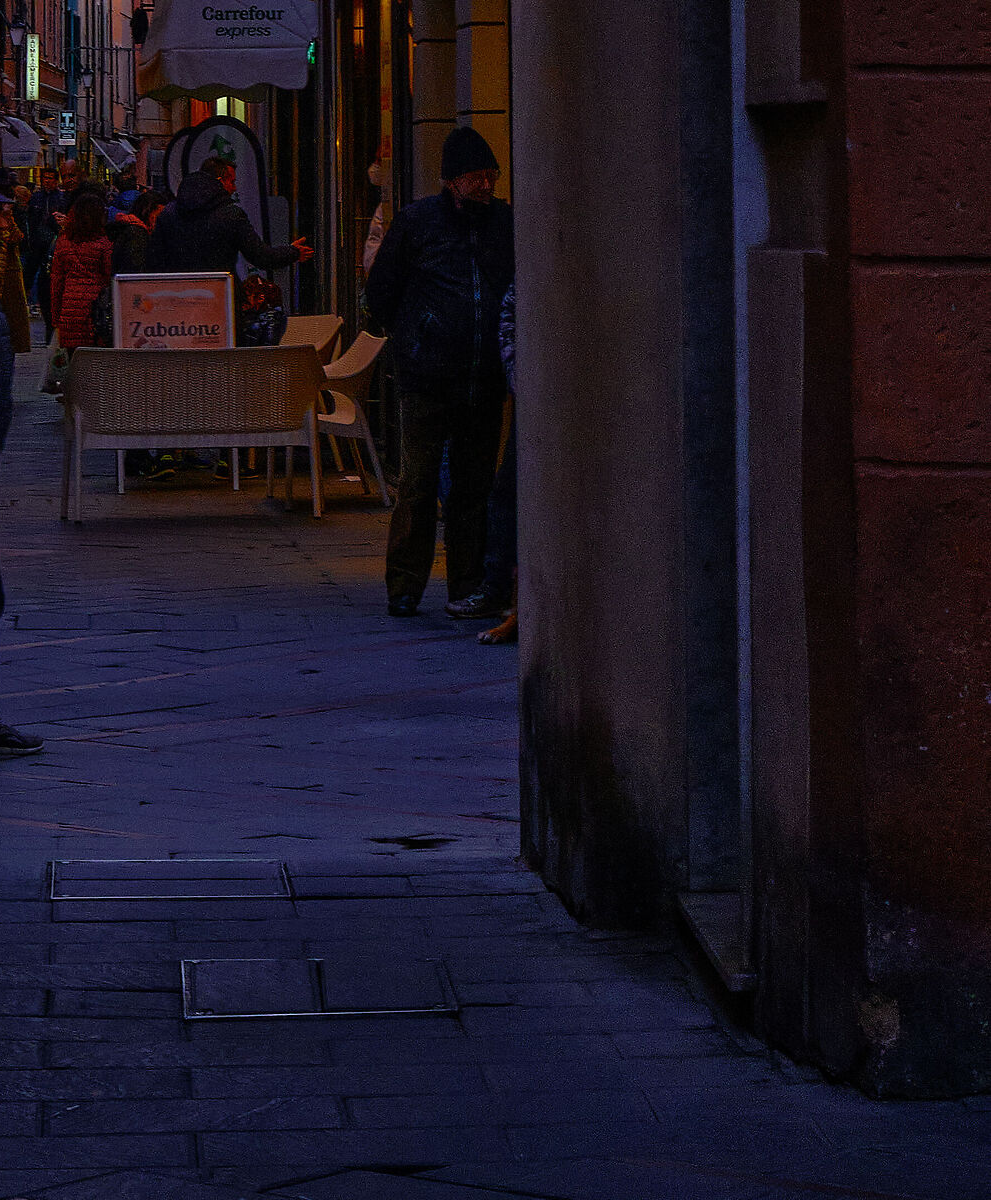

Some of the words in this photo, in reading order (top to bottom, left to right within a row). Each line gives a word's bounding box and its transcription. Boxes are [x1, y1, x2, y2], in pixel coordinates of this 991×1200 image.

[202, 6, 285, 21] Carrefour
[215, 26, 271, 39] express
[129, 320, 221, 338] Zabaione
